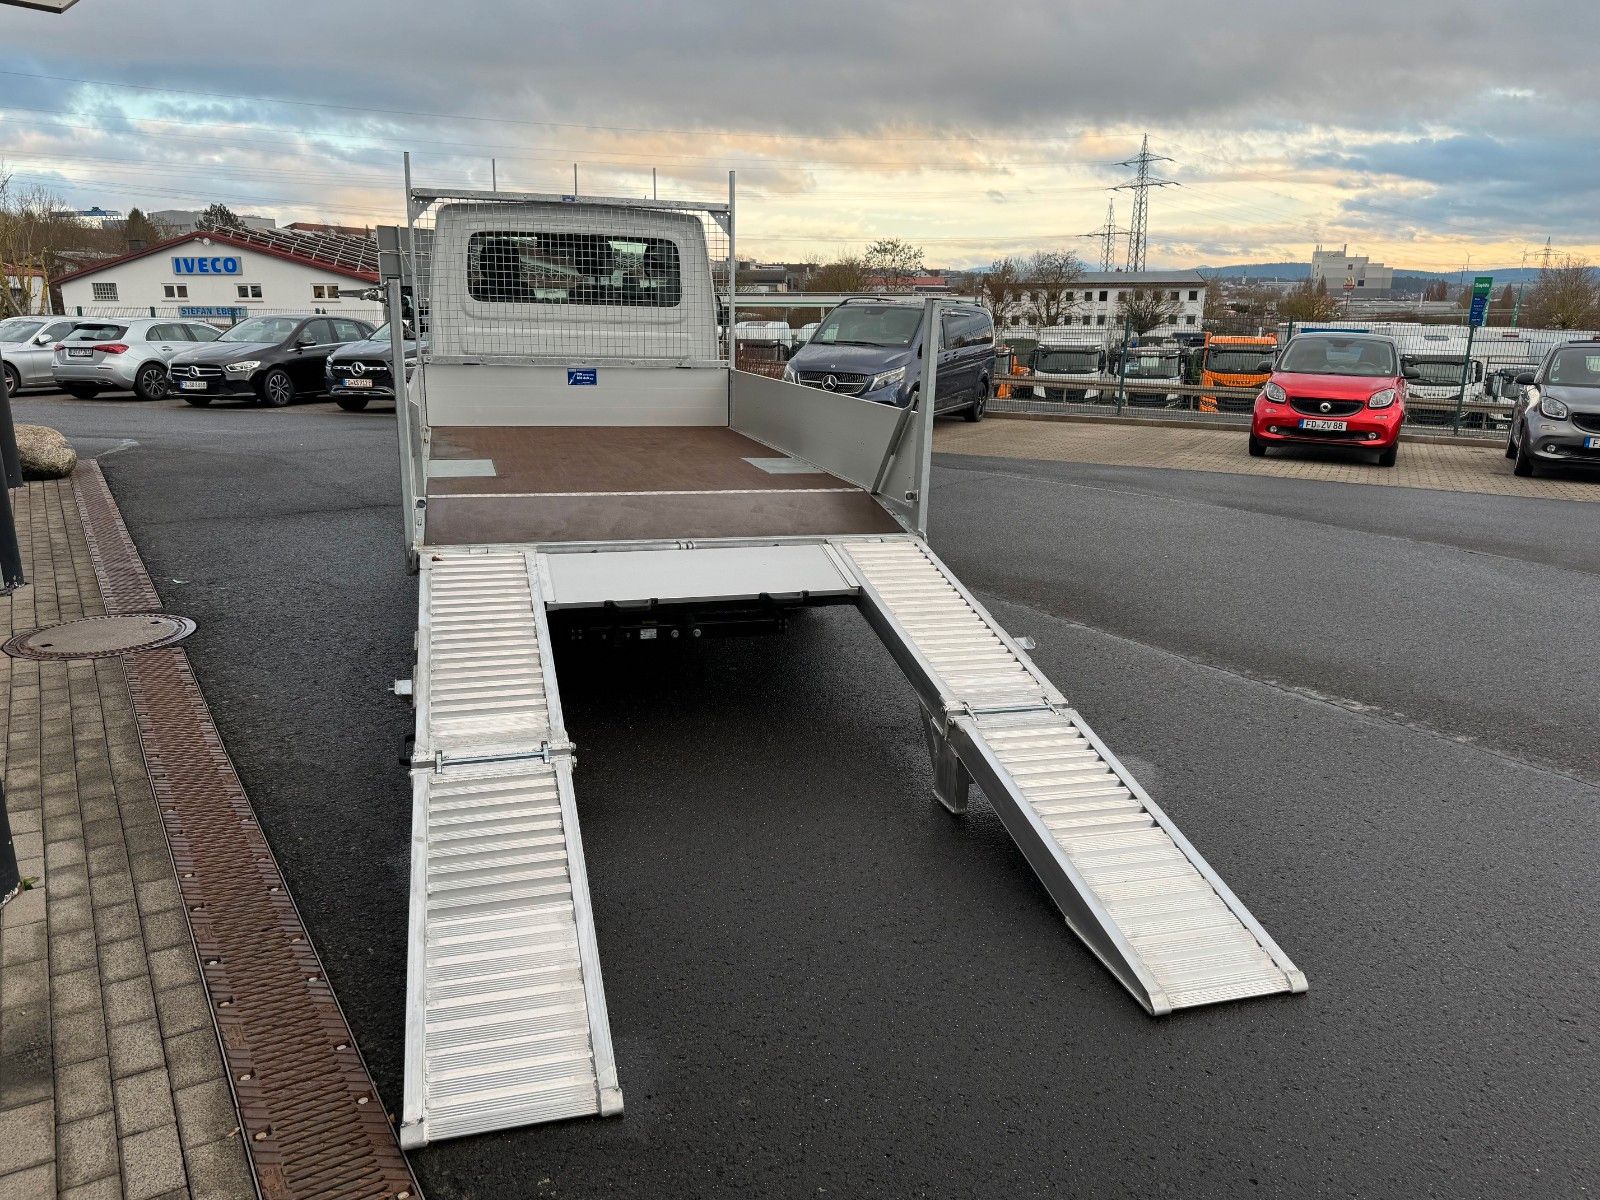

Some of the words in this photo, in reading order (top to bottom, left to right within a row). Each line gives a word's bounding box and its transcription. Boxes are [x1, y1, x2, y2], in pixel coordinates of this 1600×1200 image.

[174, 257, 237, 273] IVECO
[181, 307, 213, 316] STEFAN
[1305, 420, 1317, 428] FD
[1320, 421, 1332, 429] ZV
[1332, 421, 1344, 430] 88
